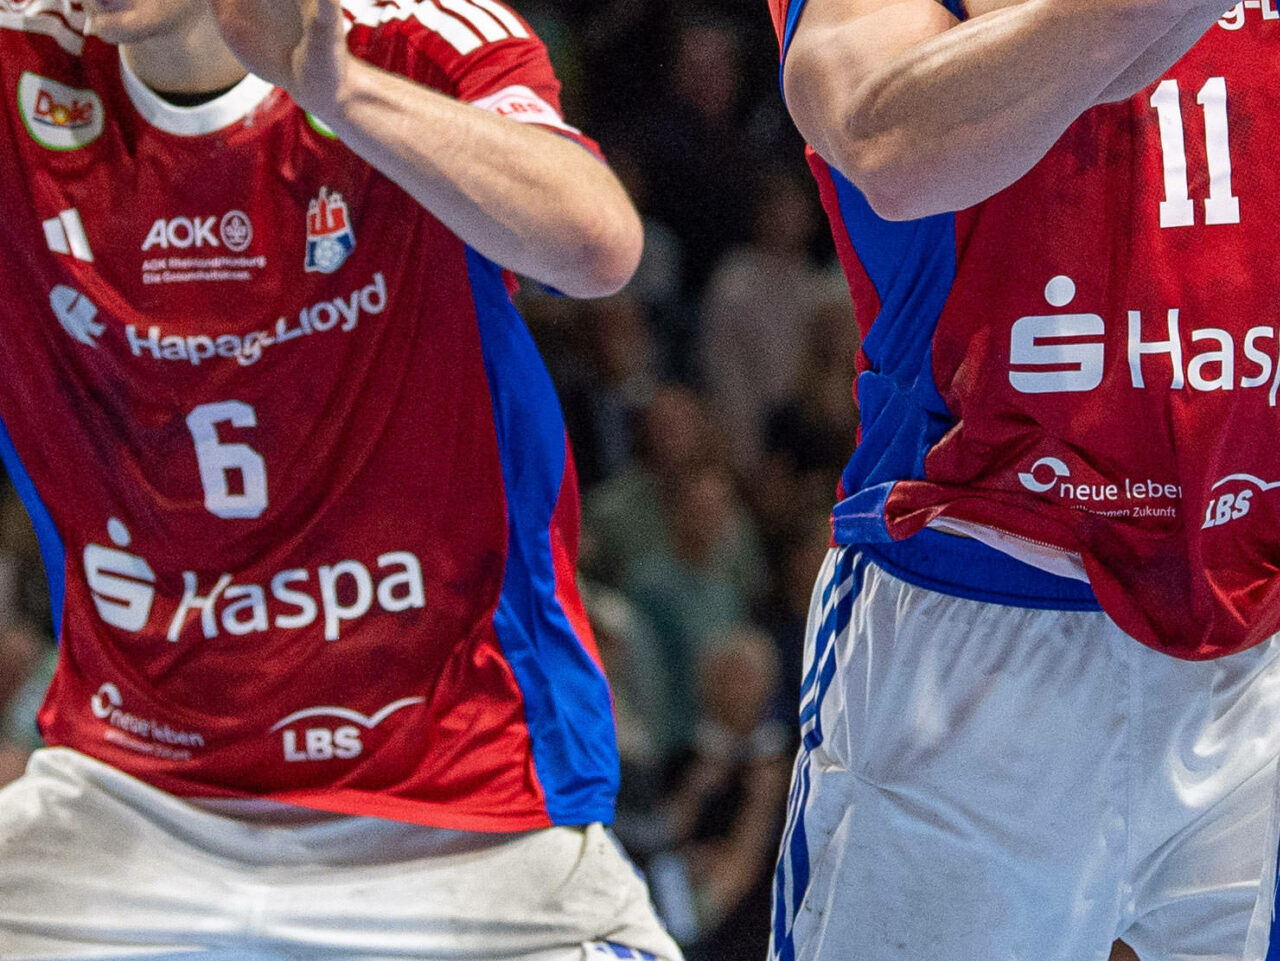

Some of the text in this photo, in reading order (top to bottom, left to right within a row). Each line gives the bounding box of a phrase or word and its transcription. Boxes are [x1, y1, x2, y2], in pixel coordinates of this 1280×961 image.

[1149, 76, 1240, 229] 11
[141, 216, 219, 251] AOK
[185, 400, 268, 519] 6
[1060, 483, 1118, 501] neue
[1201, 489, 1253, 529] LBS
[1133, 505, 1176, 518] Zukunft
[167, 551, 425, 641] Haspa
[283, 727, 362, 762] LBS
